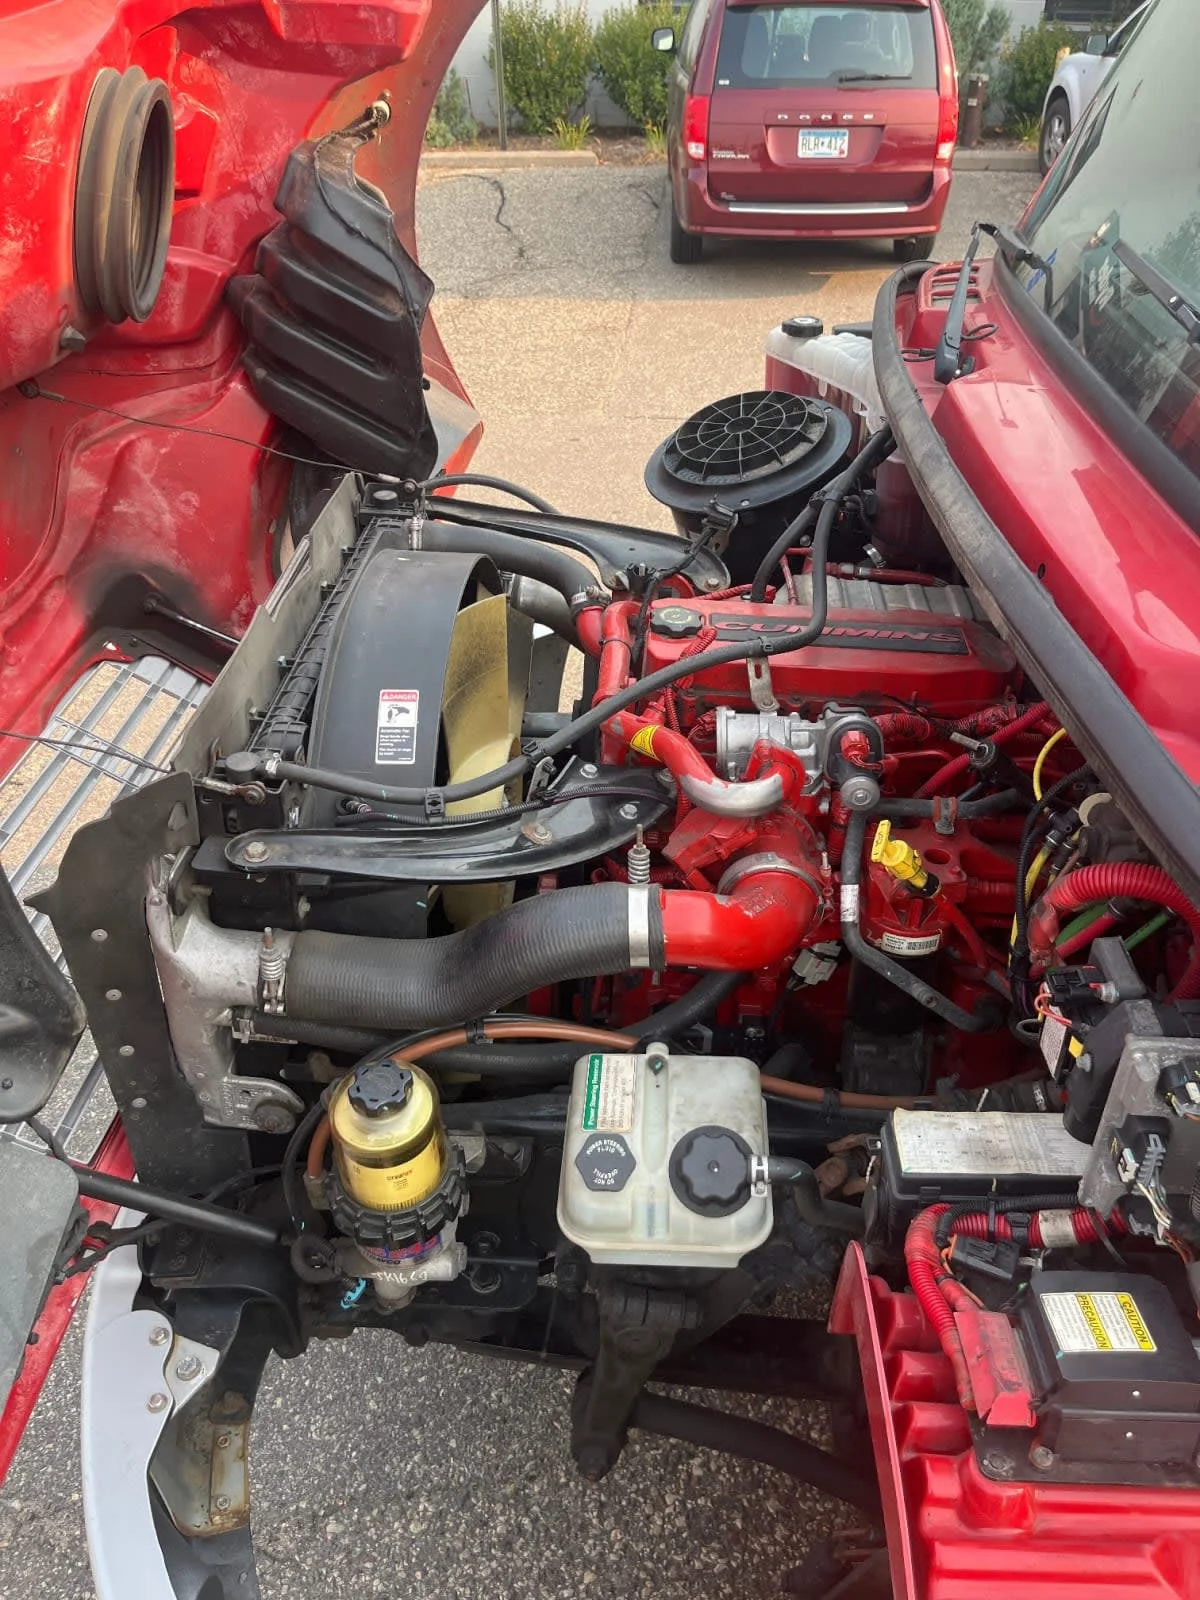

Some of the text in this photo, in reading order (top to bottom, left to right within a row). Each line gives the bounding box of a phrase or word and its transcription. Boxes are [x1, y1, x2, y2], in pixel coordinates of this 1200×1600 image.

[587, 1057, 601, 1126] Power Steering Reservoir
[586, 1140, 603, 1156] POWER
[1077, 1295, 1110, 1349] PRECAUCION
[1122, 1301, 1149, 1344] CAUTION
